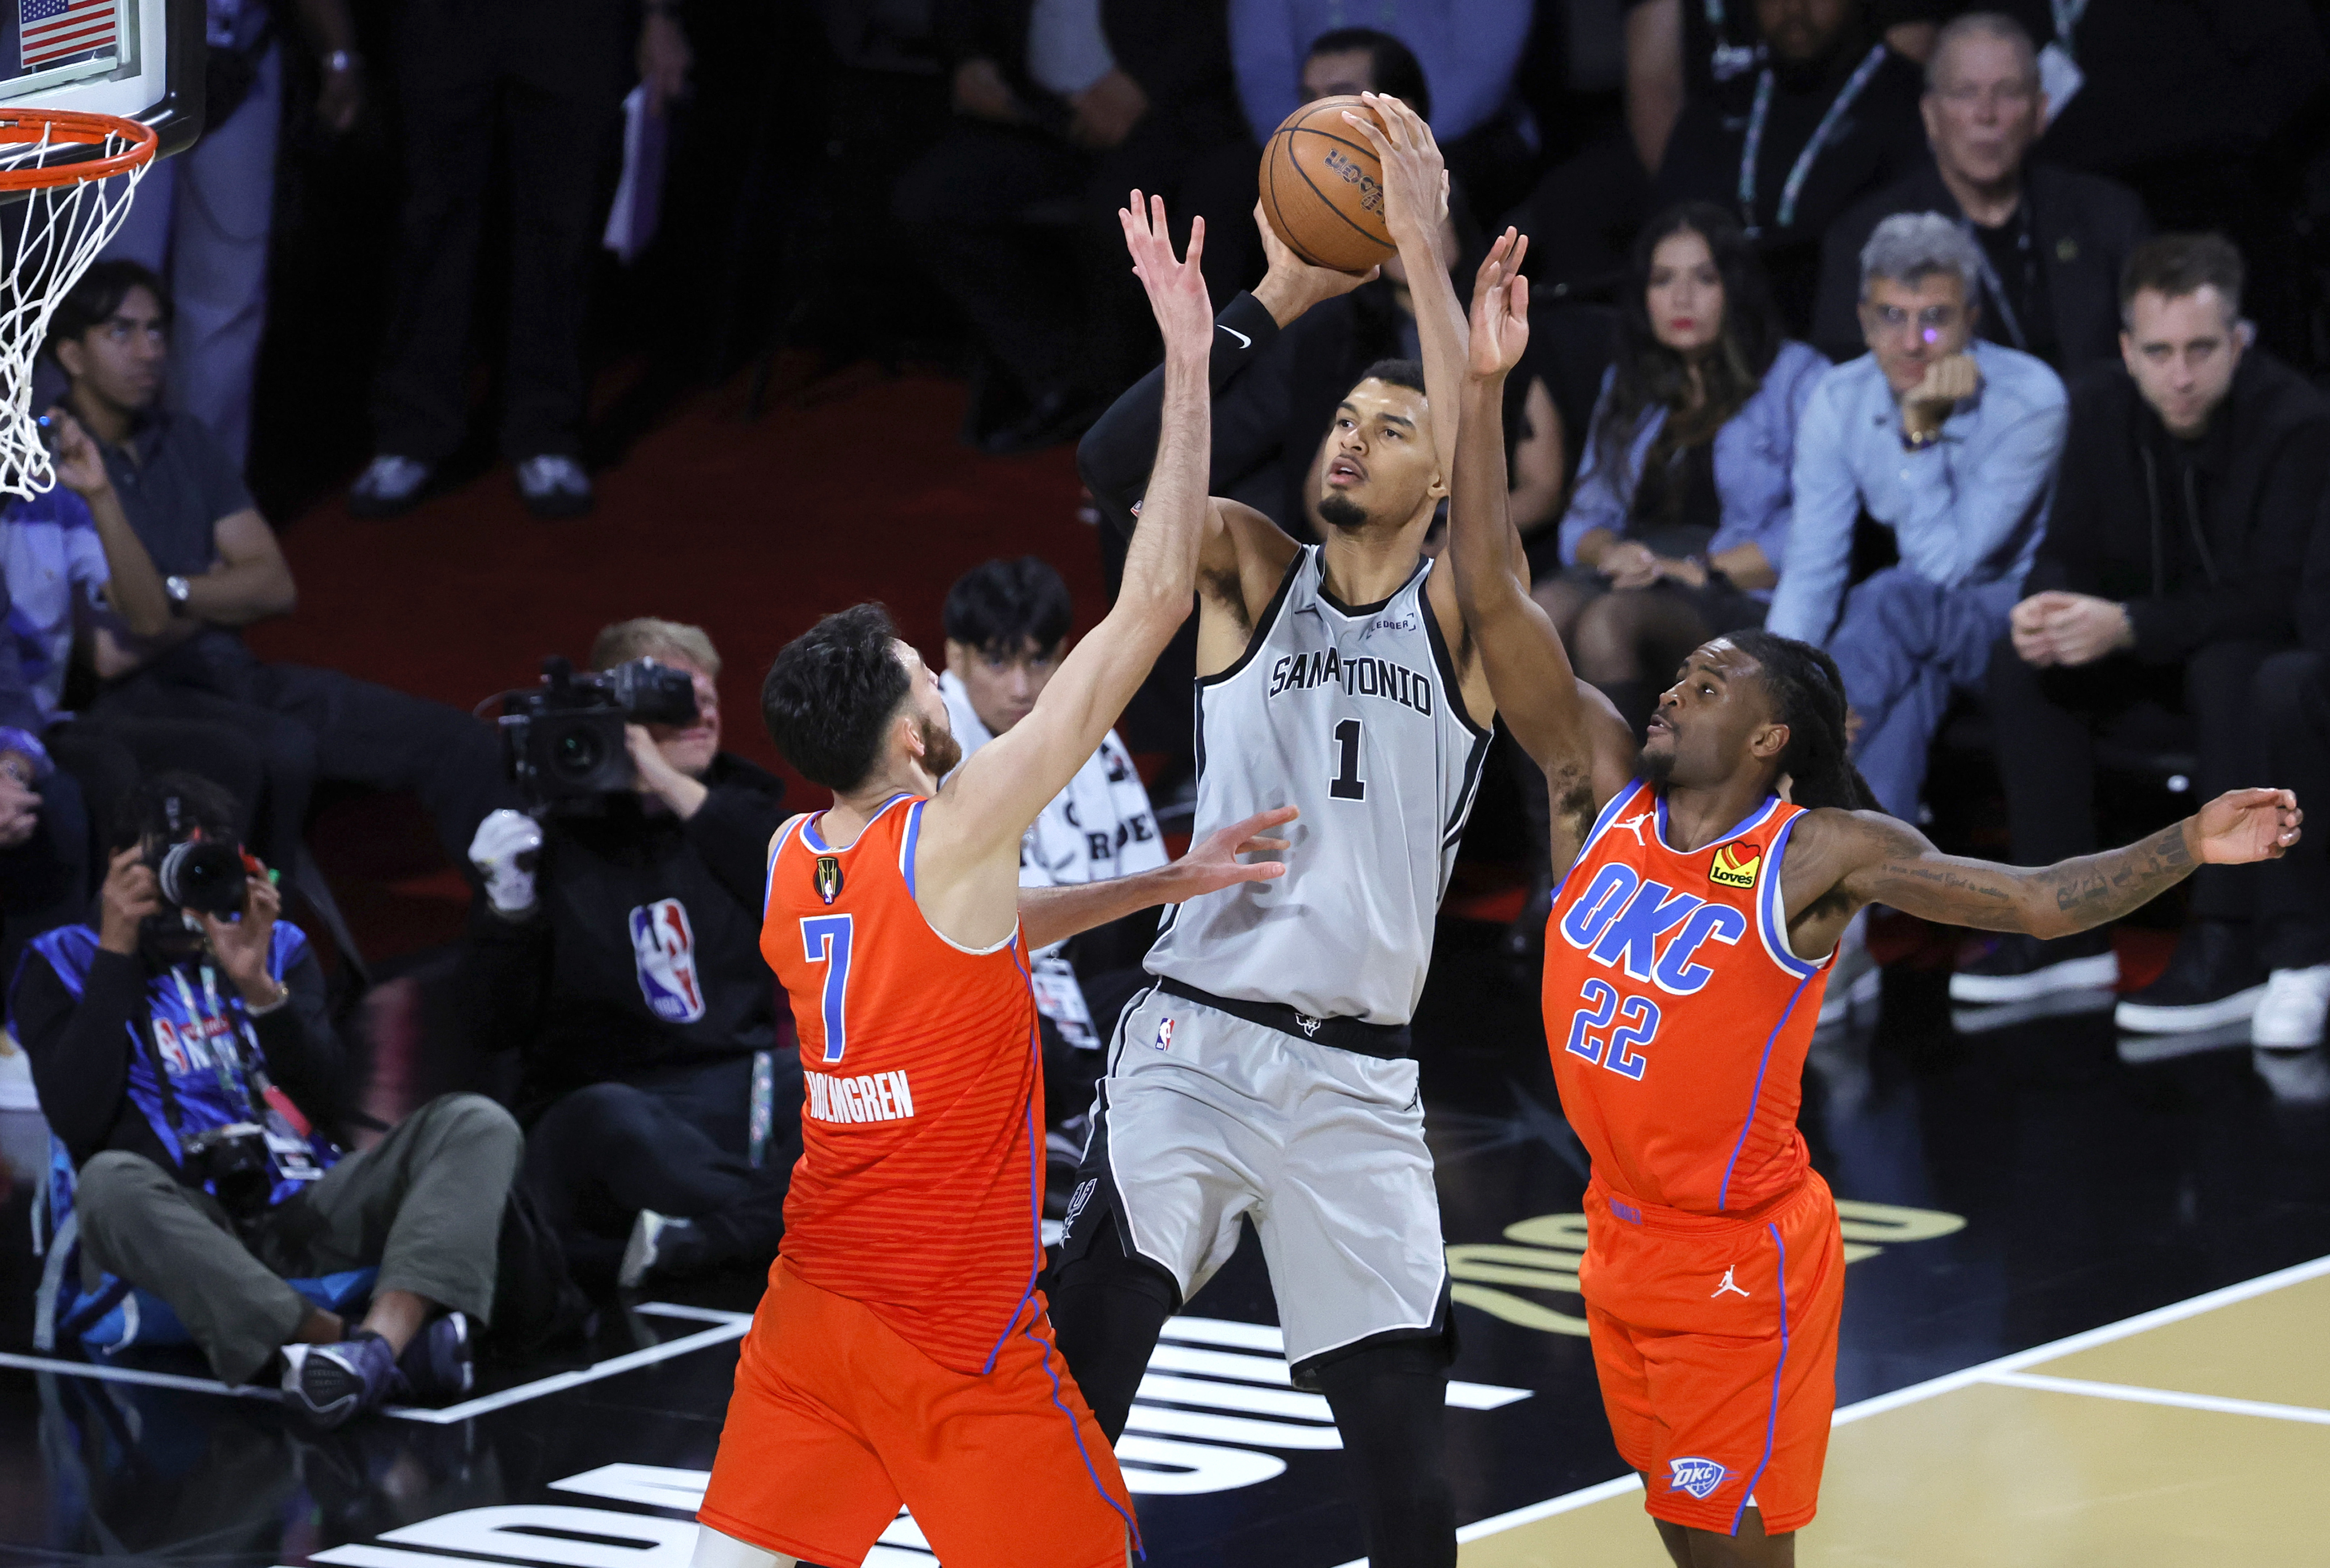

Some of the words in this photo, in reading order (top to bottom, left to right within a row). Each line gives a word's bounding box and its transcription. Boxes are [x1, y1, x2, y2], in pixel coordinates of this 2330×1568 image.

[1322, 645, 1433, 718] ATONIO
[1328, 717, 1367, 802] 1
[1560, 862, 1747, 996] OKC
[799, 913, 854, 1062] 7
[1565, 977, 1661, 1081] 22
[803, 1069, 914, 1124] HOLMGREN
[1671, 1467, 1713, 1487] OKC
